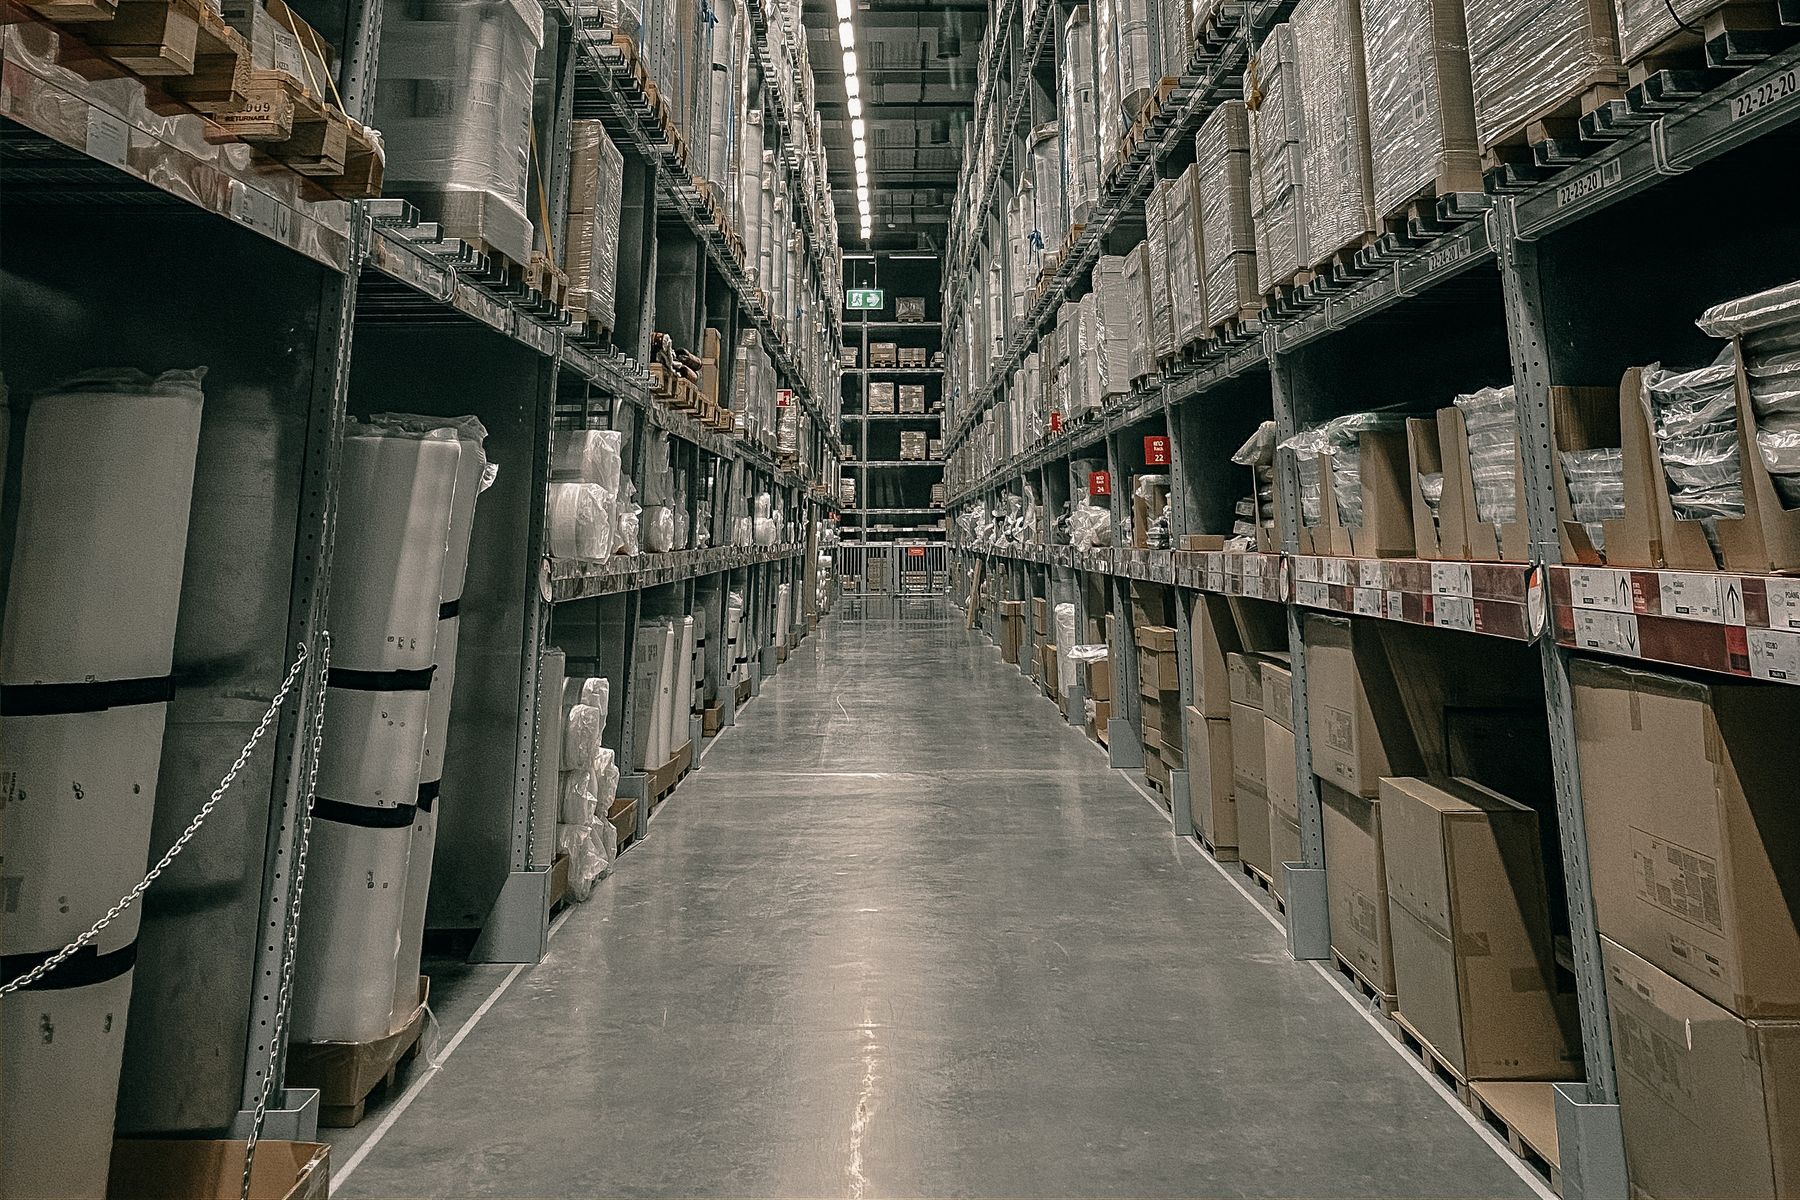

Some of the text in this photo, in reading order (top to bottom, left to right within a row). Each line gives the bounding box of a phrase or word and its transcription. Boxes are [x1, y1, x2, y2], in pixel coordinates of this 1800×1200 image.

[1737, 71, 1796, 118] 22-22-20
[1561, 172, 1598, 206] 22-23-20
[1155, 454, 1164, 462] 22
